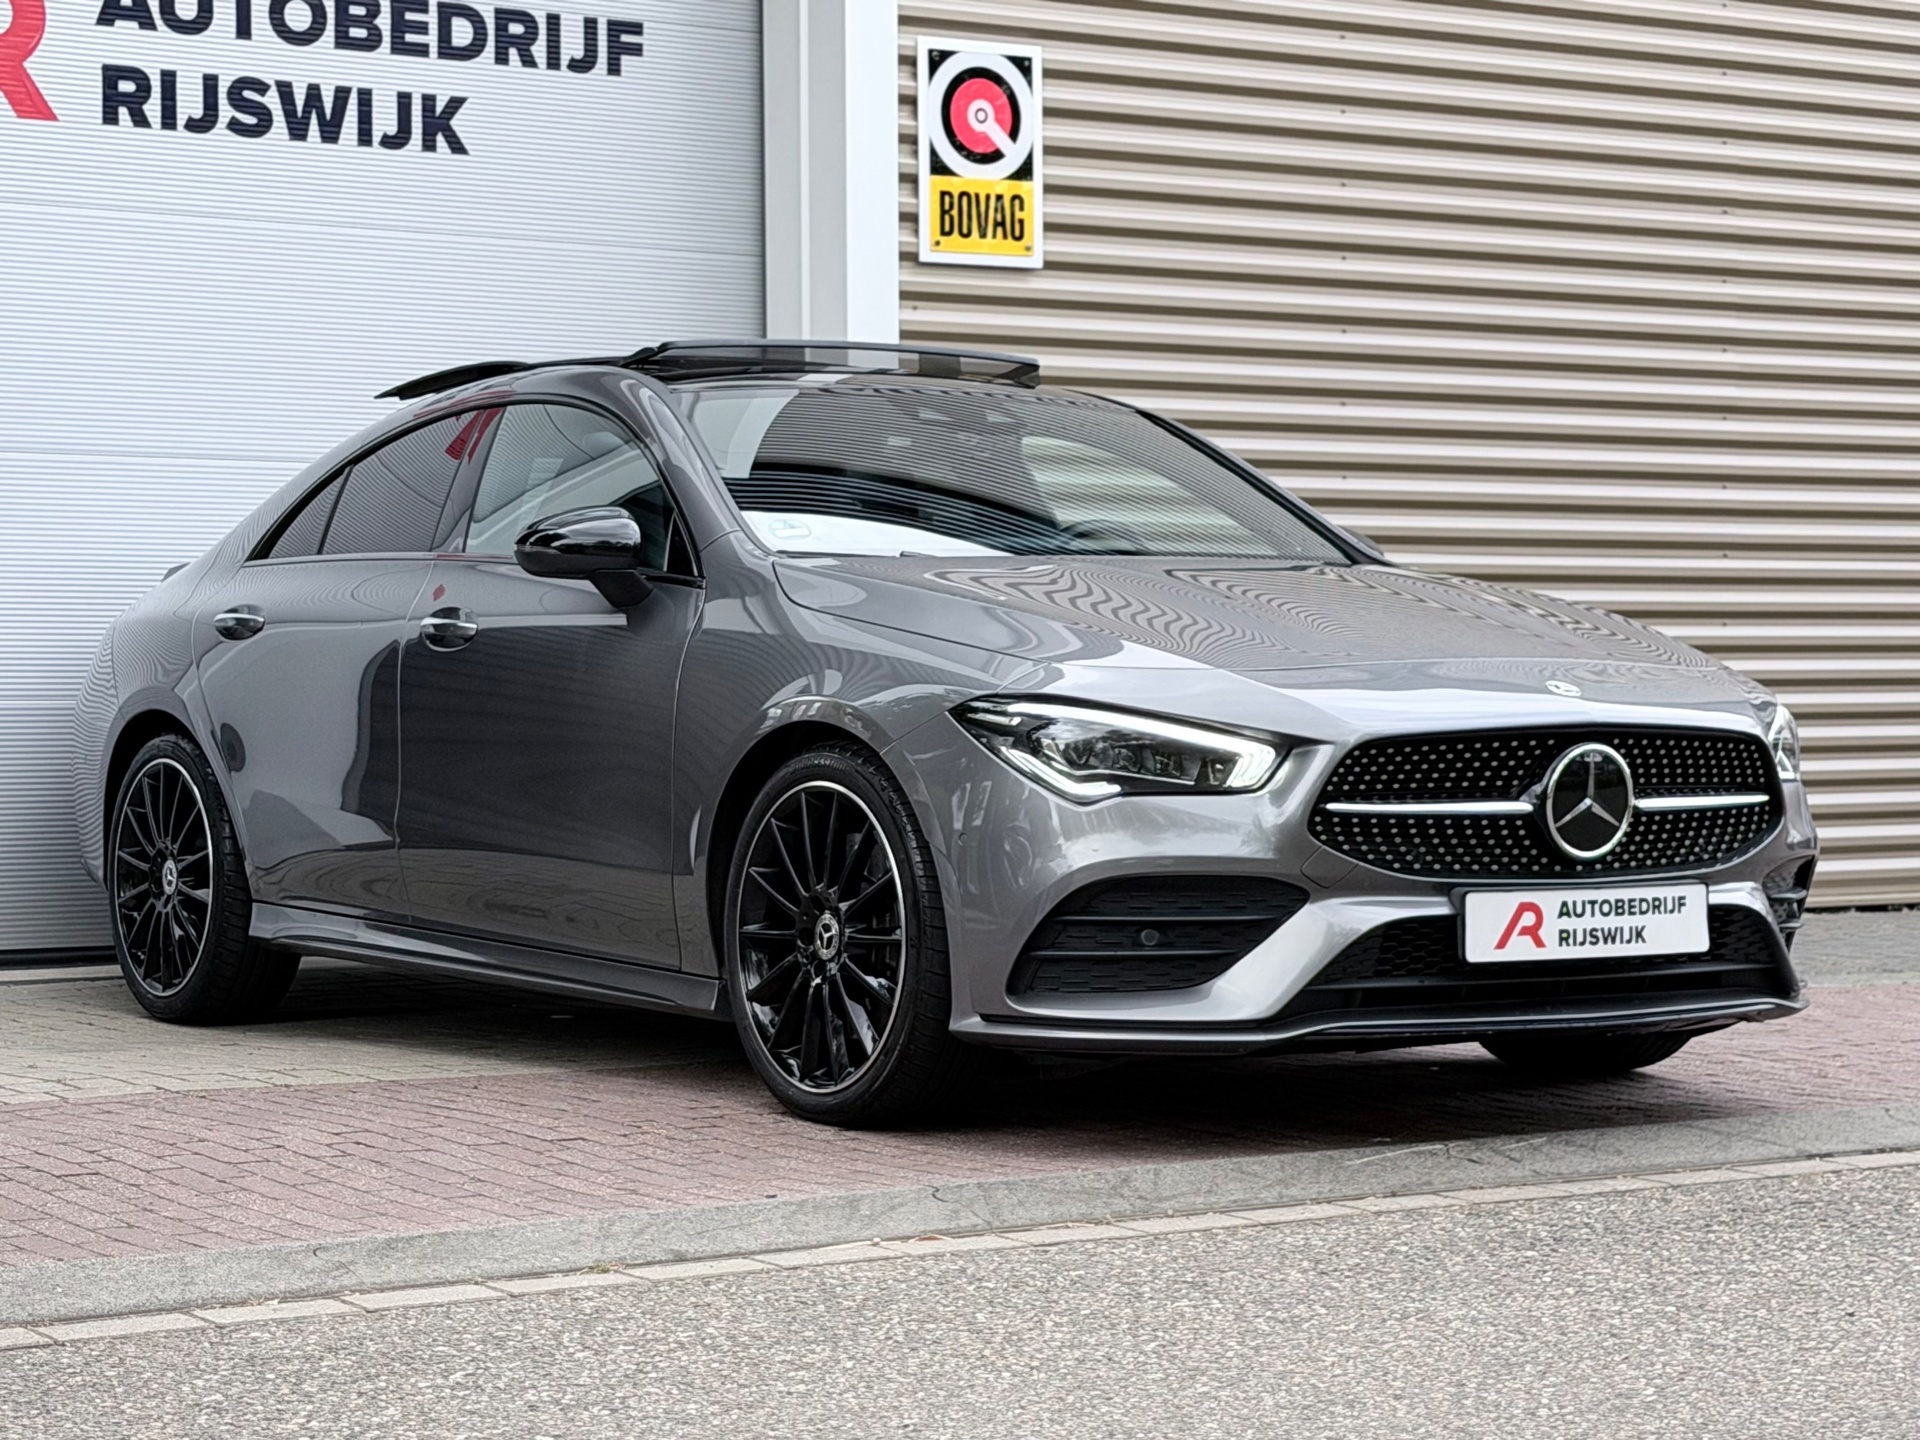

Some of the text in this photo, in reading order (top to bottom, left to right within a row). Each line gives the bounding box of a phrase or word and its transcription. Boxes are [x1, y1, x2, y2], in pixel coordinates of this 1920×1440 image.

[101, 64, 470, 156] RIJSWIJK
[939, 190, 1025, 242] BOVAG
[1557, 896, 1687, 919] AUTOBEDRIJF
[1558, 925, 1647, 948] RIJSWIJK
